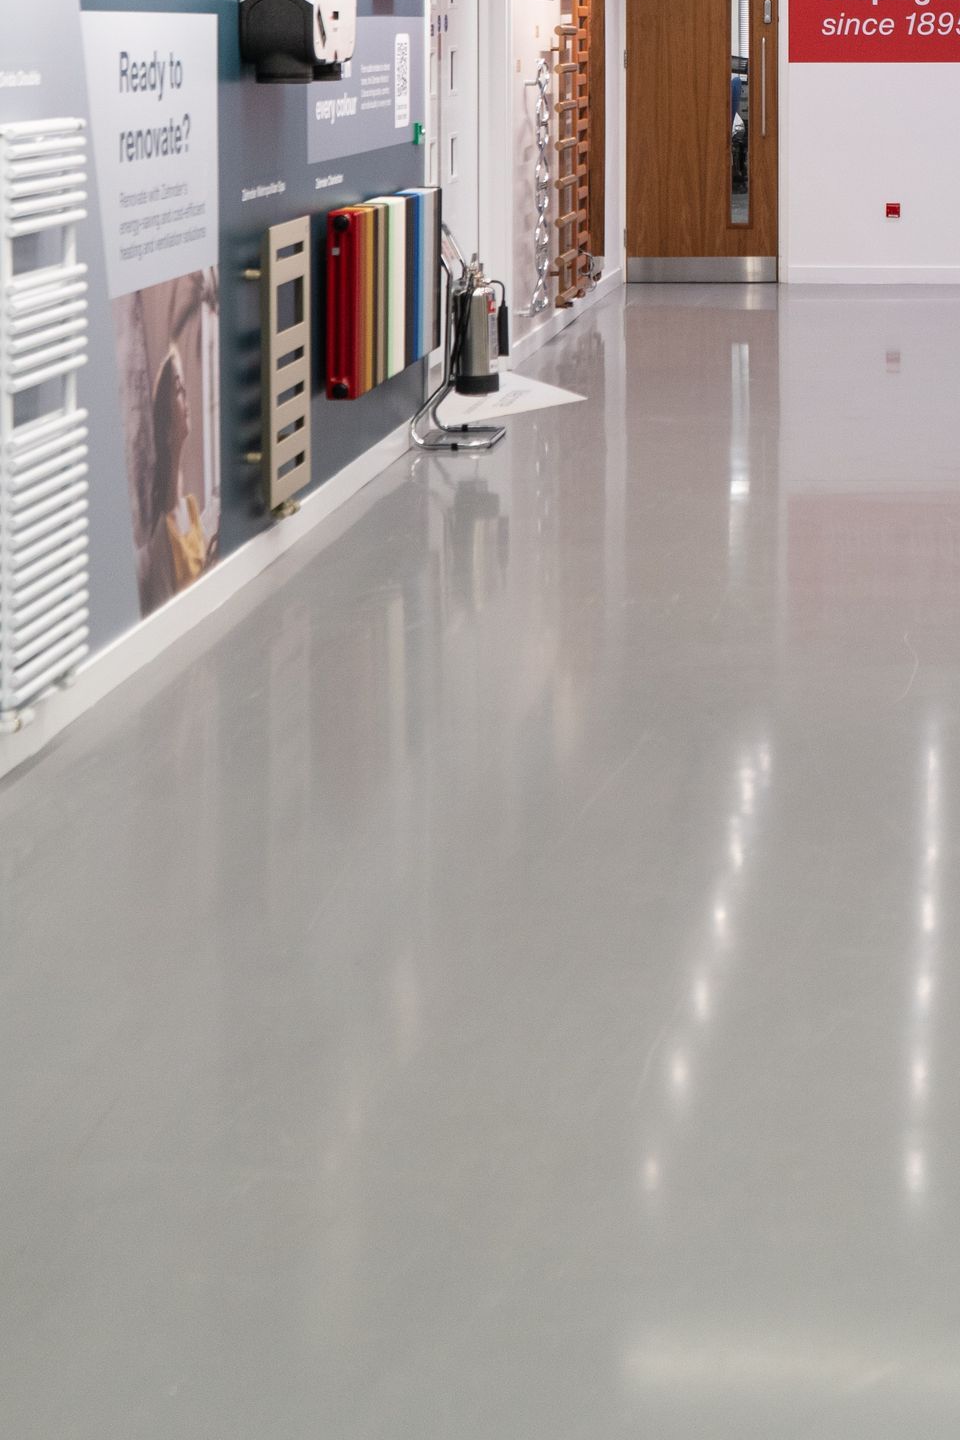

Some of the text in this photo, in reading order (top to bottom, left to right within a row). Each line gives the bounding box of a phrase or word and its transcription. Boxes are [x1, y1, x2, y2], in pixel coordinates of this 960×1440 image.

[821, 13, 895, 36] since
[119, 51, 183, 102] Ready to
[315, 92, 357, 125] every colour
[119, 113, 191, 164] renovate?
